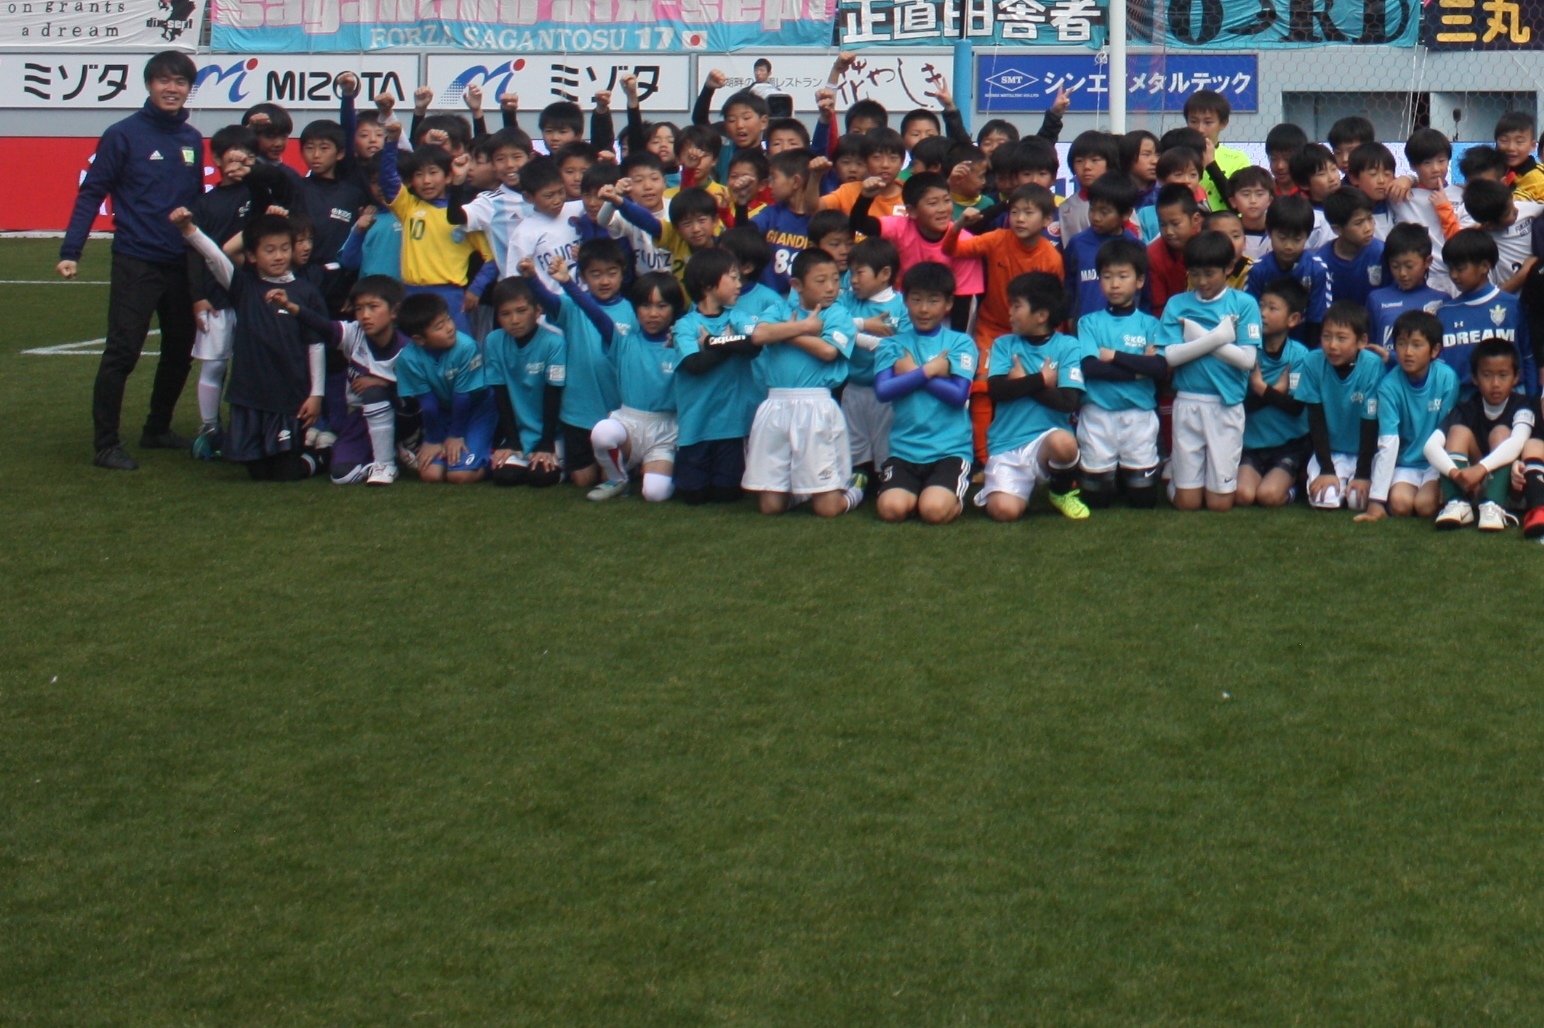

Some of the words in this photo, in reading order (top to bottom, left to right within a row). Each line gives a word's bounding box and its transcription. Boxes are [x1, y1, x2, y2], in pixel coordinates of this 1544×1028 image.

[45, 0, 125, 14] grants
[21, 27, 29, 37] a
[41, 22, 119, 38] dream
[369, 25, 455, 50] FORZA
[634, 26, 674, 51] 17
[24, 62, 130, 102] ミゾタ
[266, 70, 404, 102] MIZOTA
[550, 63, 660, 103] ミゾタ
[1001, 75, 1023, 84] SMT
[1044, 70, 1252, 95] シンエメタルテック
[408, 217, 426, 241] 10
[1442, 328, 1516, 348] DREAM
